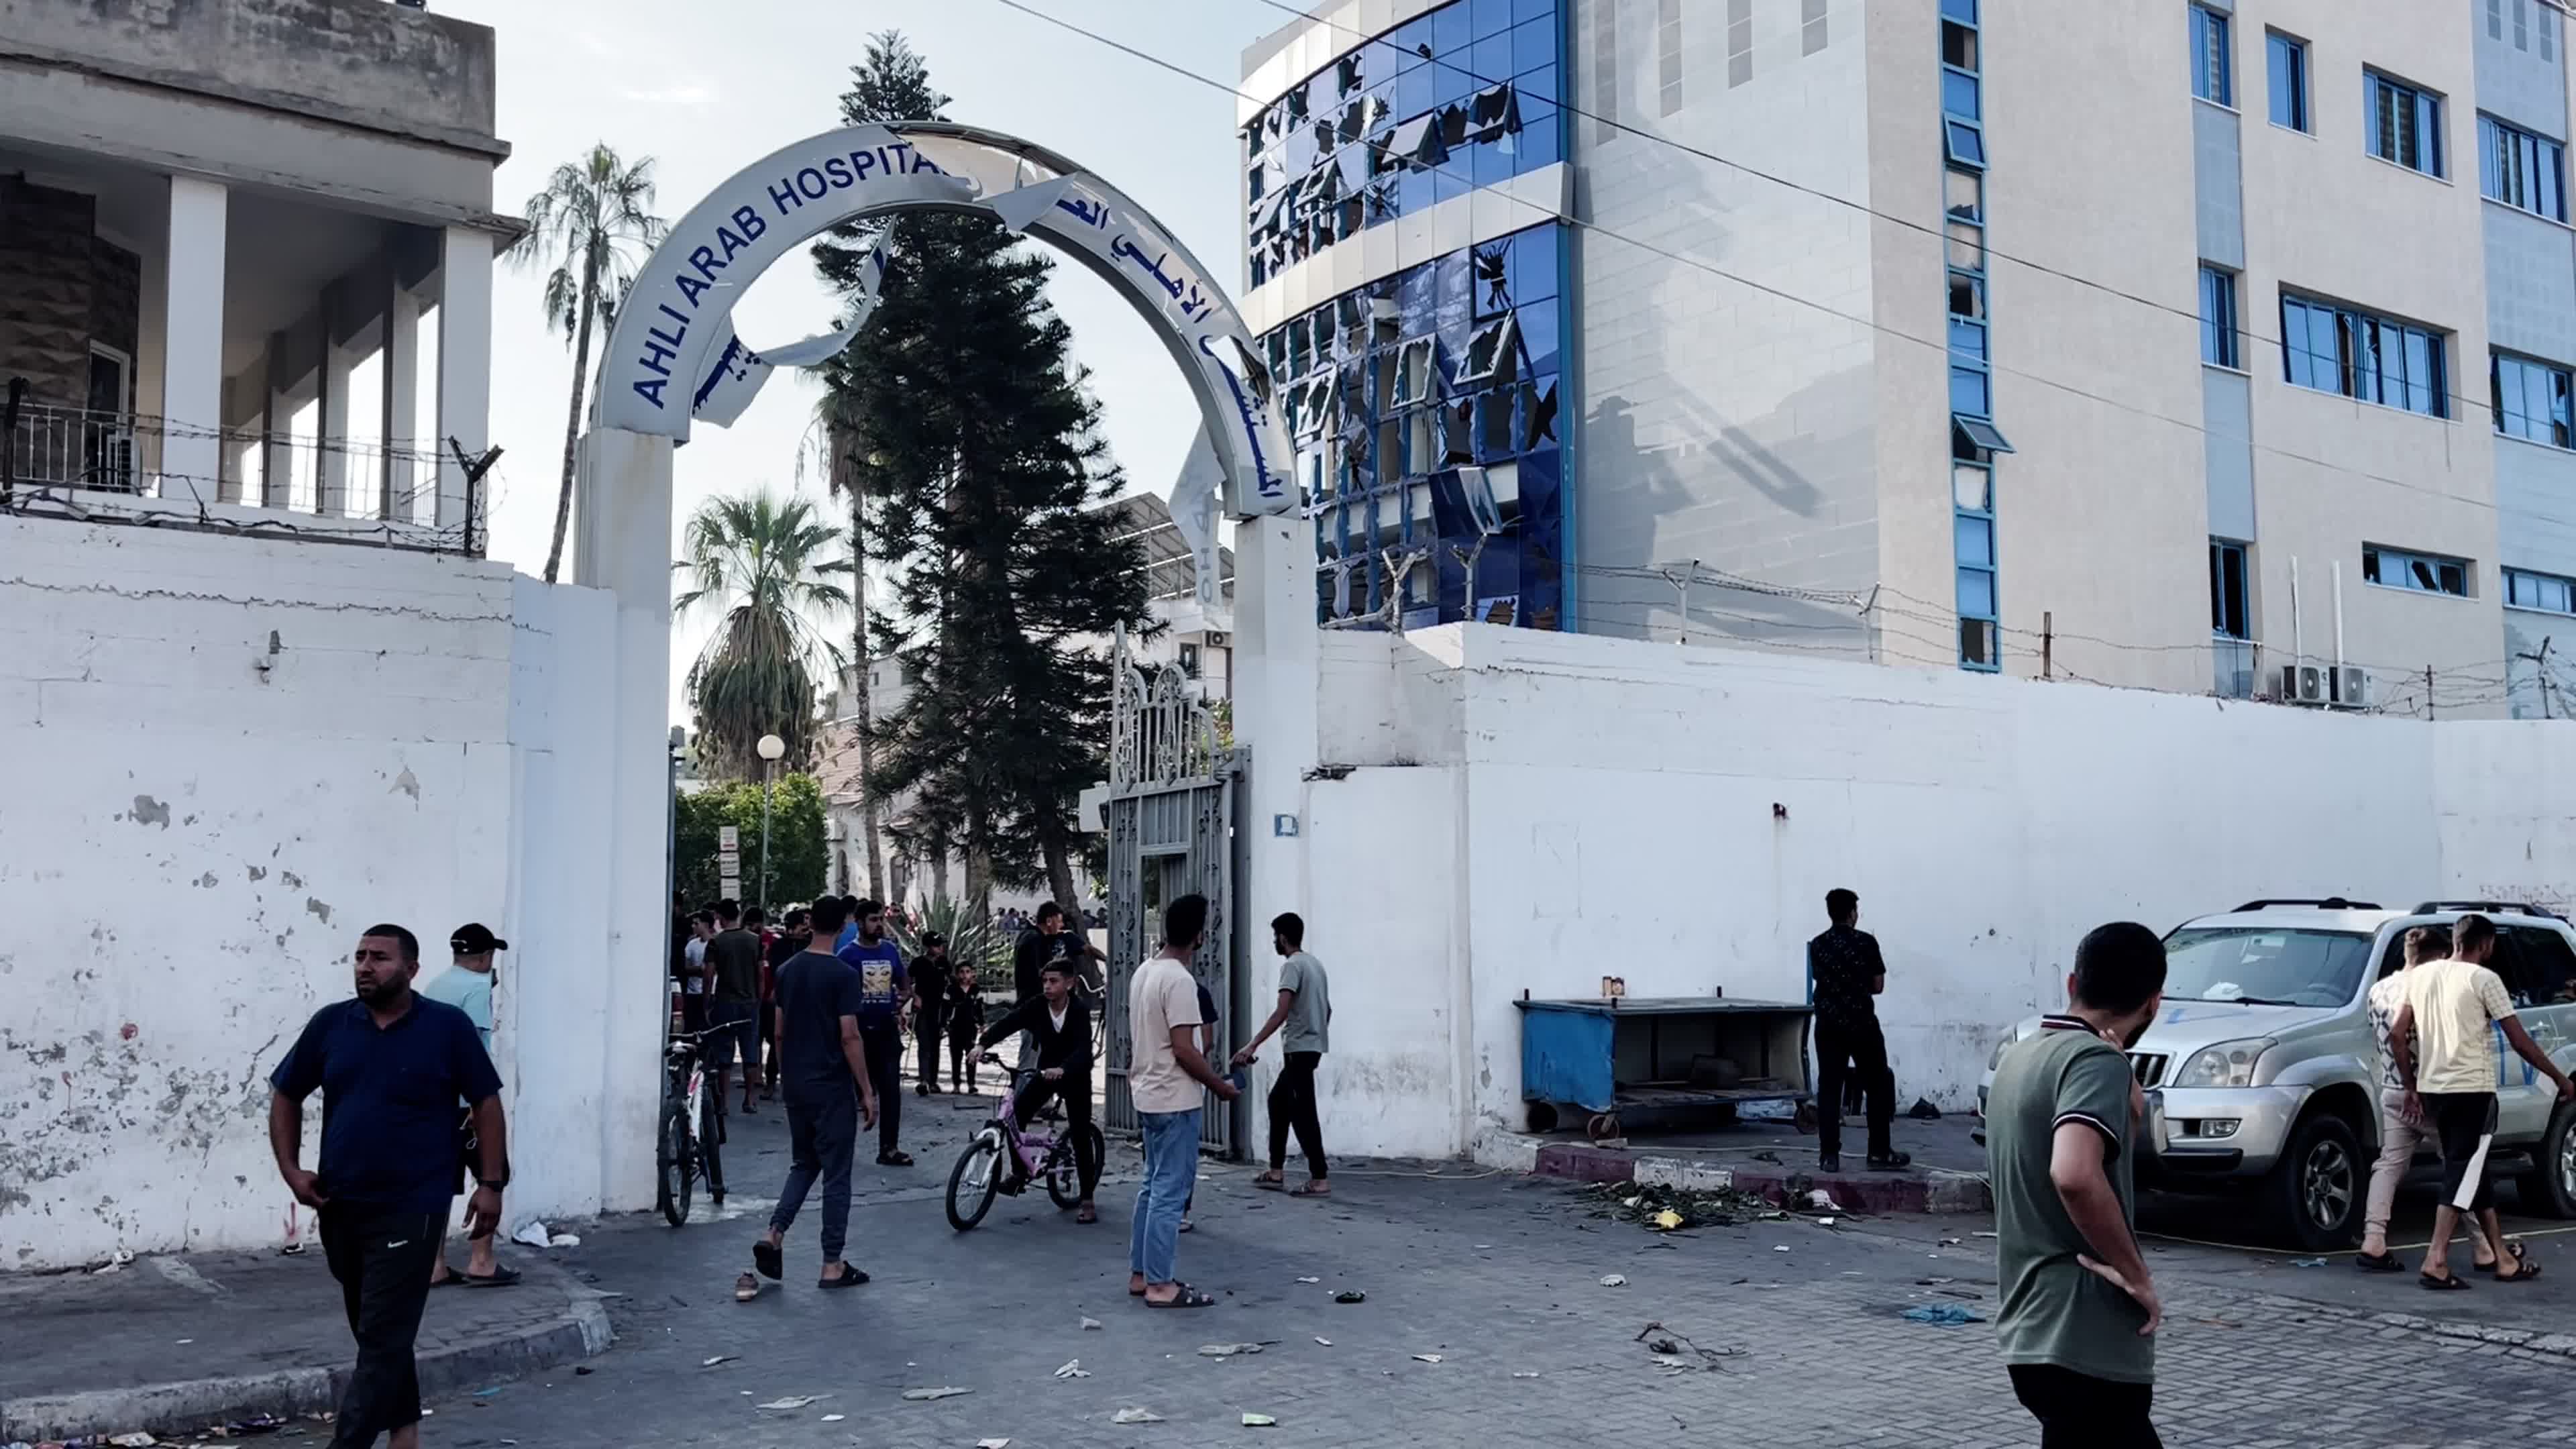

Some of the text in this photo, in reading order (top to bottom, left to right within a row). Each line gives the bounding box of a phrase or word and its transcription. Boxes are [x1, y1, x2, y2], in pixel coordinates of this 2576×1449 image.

[633, 303, 690, 410] AHLI
[675, 205, 766, 309] ARAB
[767, 144, 951, 216] HOSPITA
